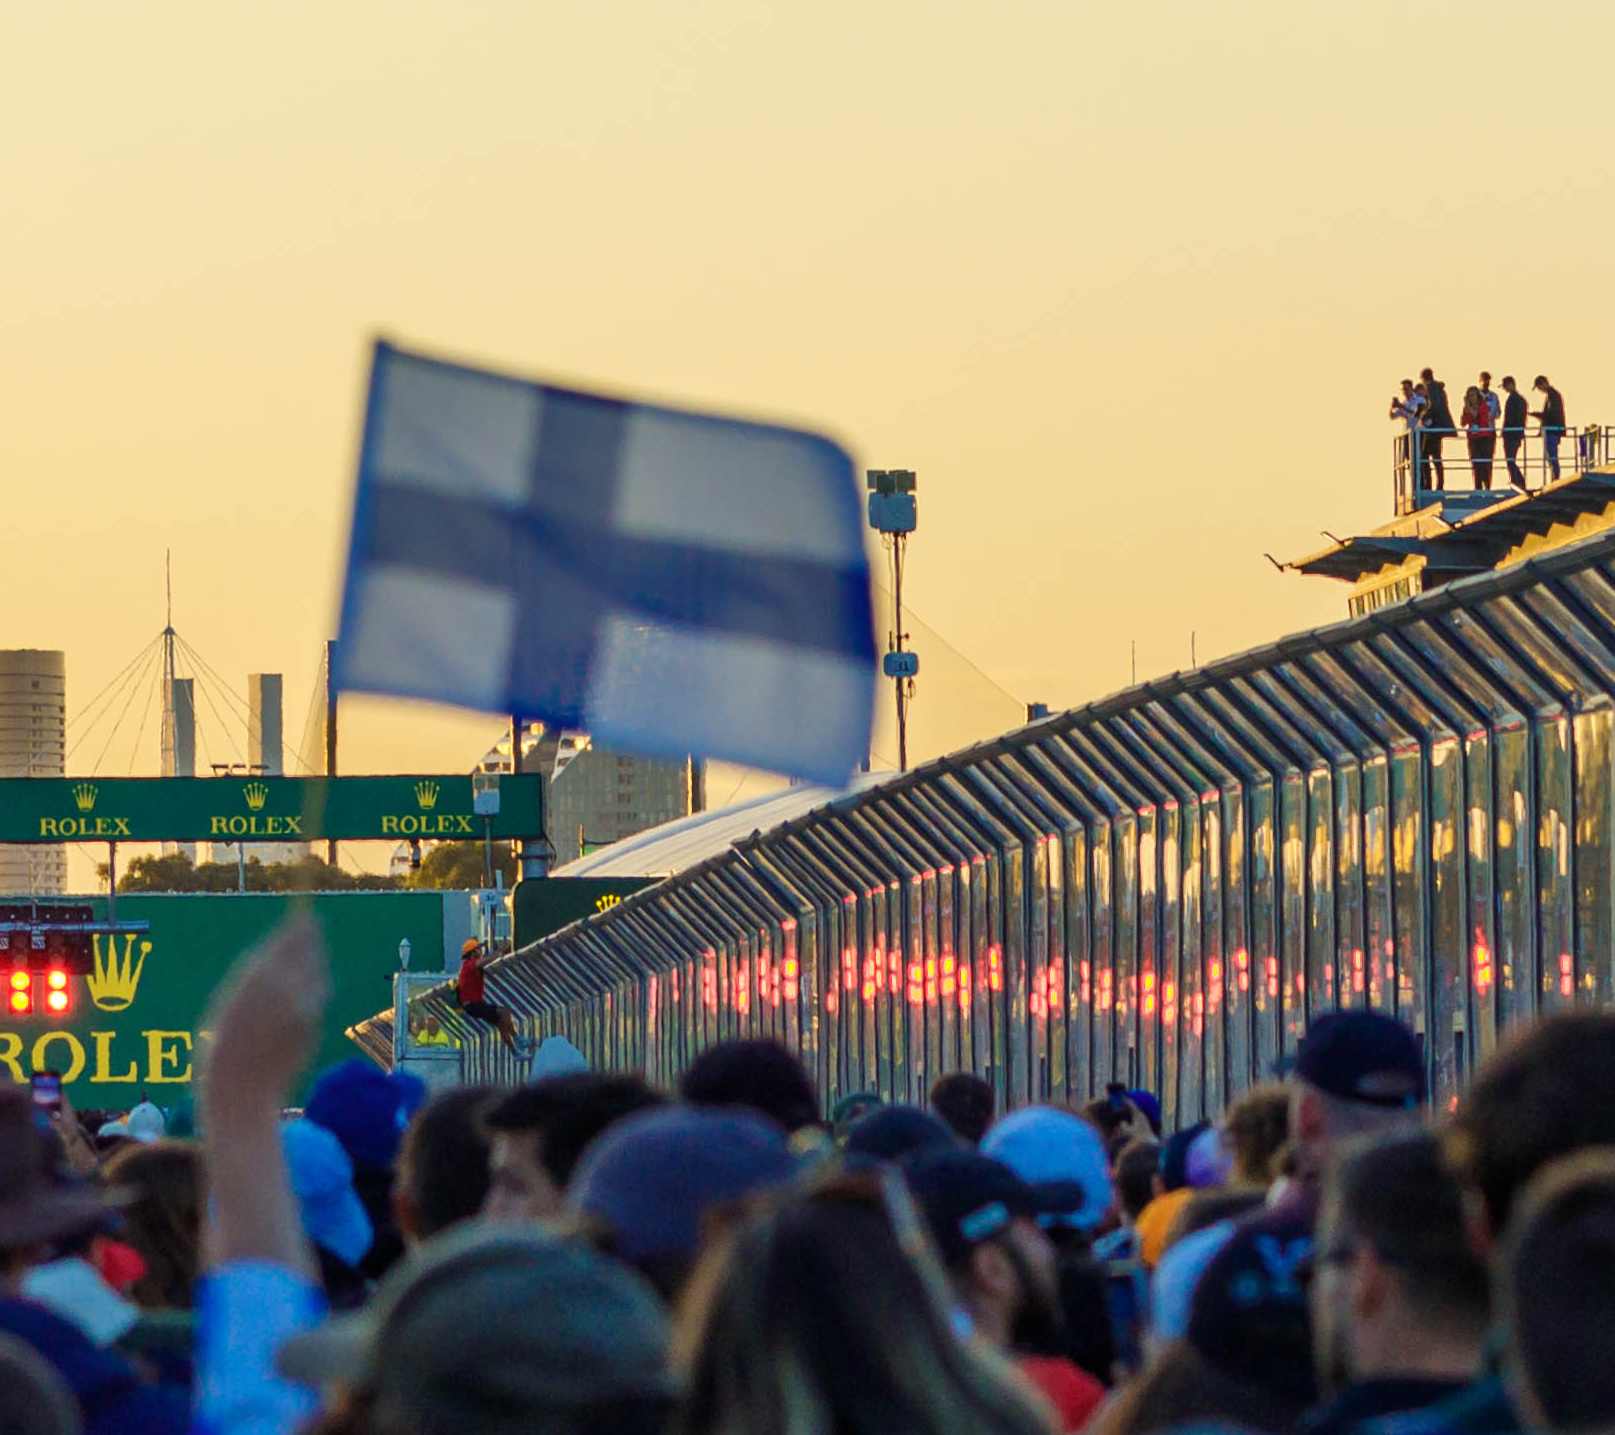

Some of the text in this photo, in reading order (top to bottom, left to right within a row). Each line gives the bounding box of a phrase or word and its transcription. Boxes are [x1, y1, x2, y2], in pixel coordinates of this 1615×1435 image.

[39, 816, 132, 836] ROLEX
[210, 815, 303, 835] ROLEX
[382, 813, 474, 834] ROLEX
